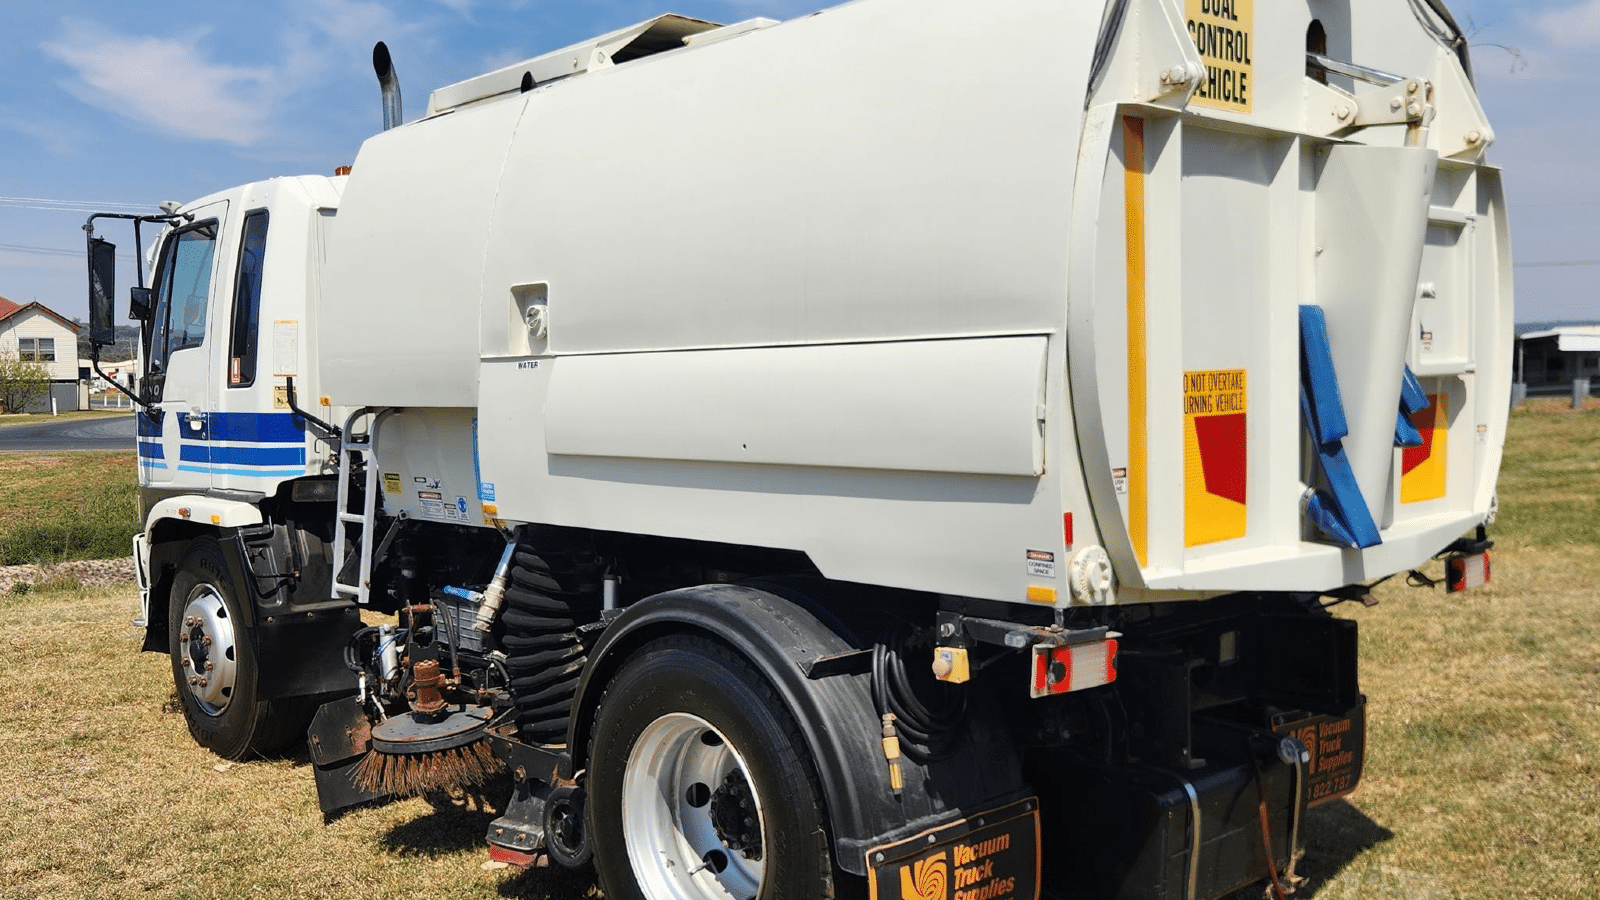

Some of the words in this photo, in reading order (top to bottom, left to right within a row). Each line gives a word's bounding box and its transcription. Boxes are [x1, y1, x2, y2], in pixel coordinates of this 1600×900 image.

[1193, 64, 1247, 105] HICLE
[518, 361, 538, 370] WATER
[141, 384, 160, 396] HNO
[1191, 373, 1205, 392] NOT
[1208, 372, 1243, 391] OVERTAKE
[1184, 394, 1212, 415] URNING
[1215, 392, 1243, 412] VEHICLE
[1028, 561, 1053, 569] CONFINED
[1319, 718, 1350, 738] Vacuum
[1319, 736, 1341, 755] Truck
[1318, 750, 1354, 773] Supplies
[953, 833, 1010, 867] Vacuum
[954, 858, 994, 890] Truck
